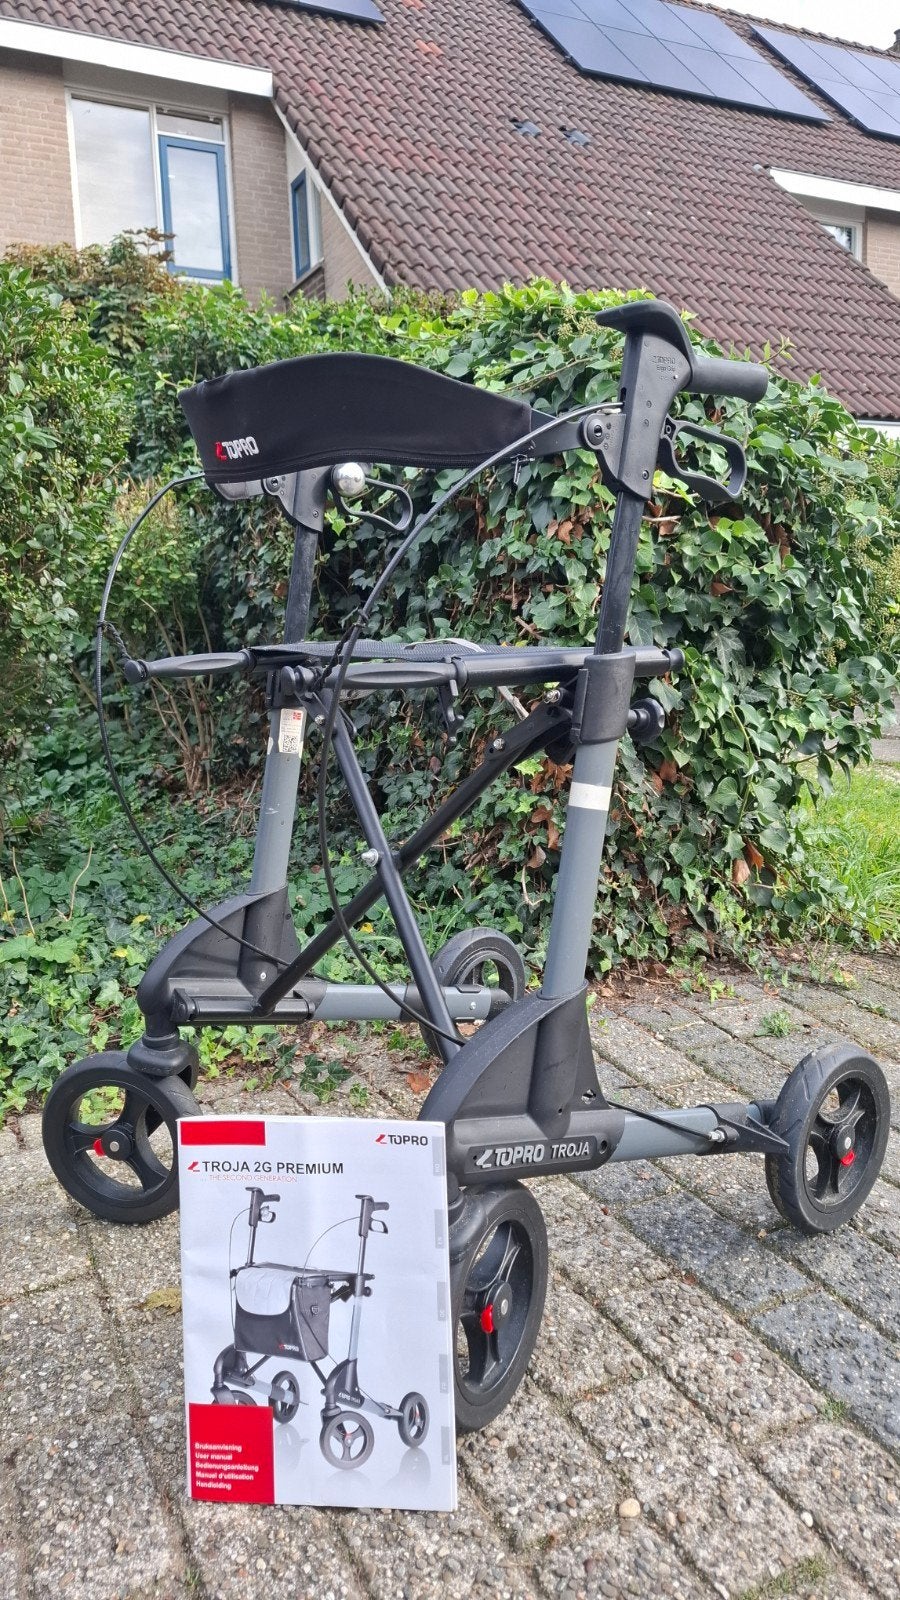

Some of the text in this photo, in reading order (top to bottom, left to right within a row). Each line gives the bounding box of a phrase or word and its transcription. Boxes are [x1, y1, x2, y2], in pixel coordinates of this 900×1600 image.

[221, 436, 260, 460] TOPRO
[387, 1134, 429, 1147] TOPRO
[495, 1141, 590, 1167] TOPRO TROJA
[202, 1161, 344, 1175] TROJA 2G PREMIUM
[253, 1174, 298, 1183] GENERATION
[194, 1443, 242, 1452] Bruksanvisning
[210, 1453, 233, 1461] manual
[195, 1461, 259, 1472] Bedienungsanleitung
